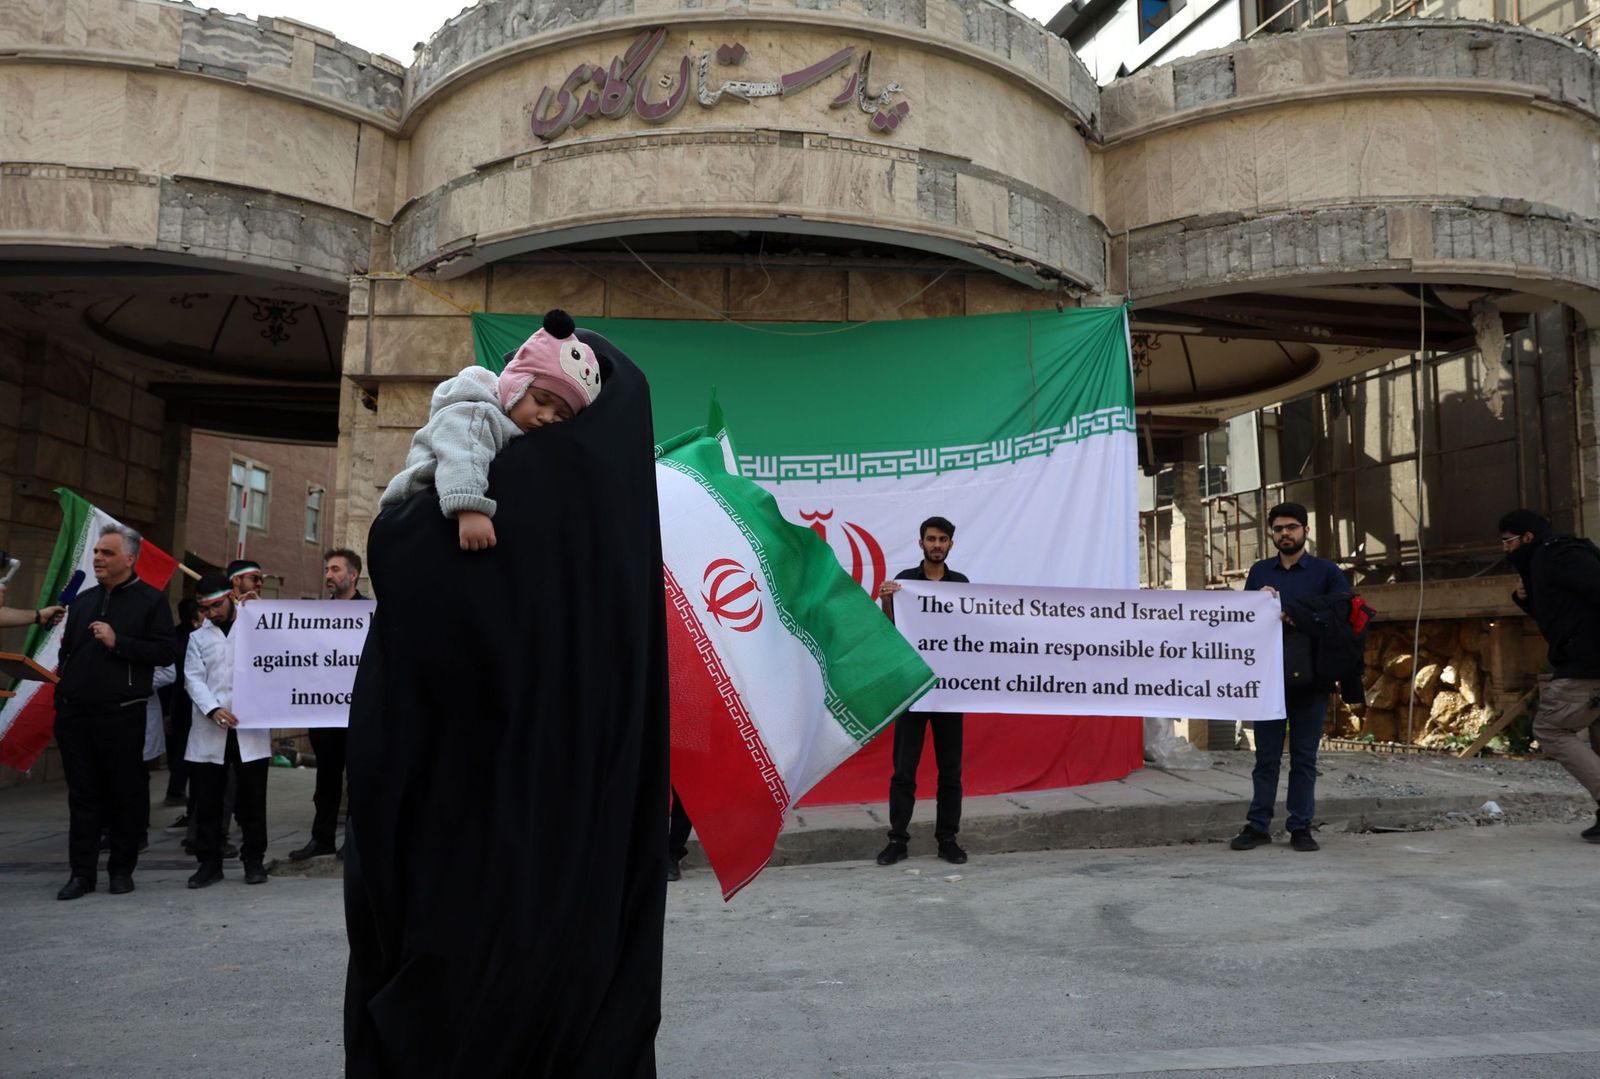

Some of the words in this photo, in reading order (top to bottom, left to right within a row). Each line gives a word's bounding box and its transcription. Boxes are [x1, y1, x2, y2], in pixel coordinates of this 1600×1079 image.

[531, 26, 668, 142] گاندی
[254, 612, 283, 630] All
[288, 612, 364, 630] humans
[917, 595, 954, 614] The
[960, 597, 1025, 616] United
[1031, 599, 1086, 618] States
[1091, 601, 1127, 619] and
[1132, 602, 1185, 621] Israel
[1190, 605, 1256, 627] regime
[252, 650, 319, 674] against
[323, 649, 360, 668] slau
[917, 638, 949, 653] are
[953, 633, 985, 653] the
[989, 636, 1040, 655] main
[1045, 639, 1155, 662] responsible
[1160, 640, 1188, 659] for
[1192, 640, 1256, 667] killing
[291, 687, 353, 706] innoce
[935, 675, 1001, 692] nocent
[1006, 673, 1088, 695] children
[1093, 676, 1130, 696] and
[1135, 678, 1212, 698] medical
[1217, 680, 1261, 699] staff
